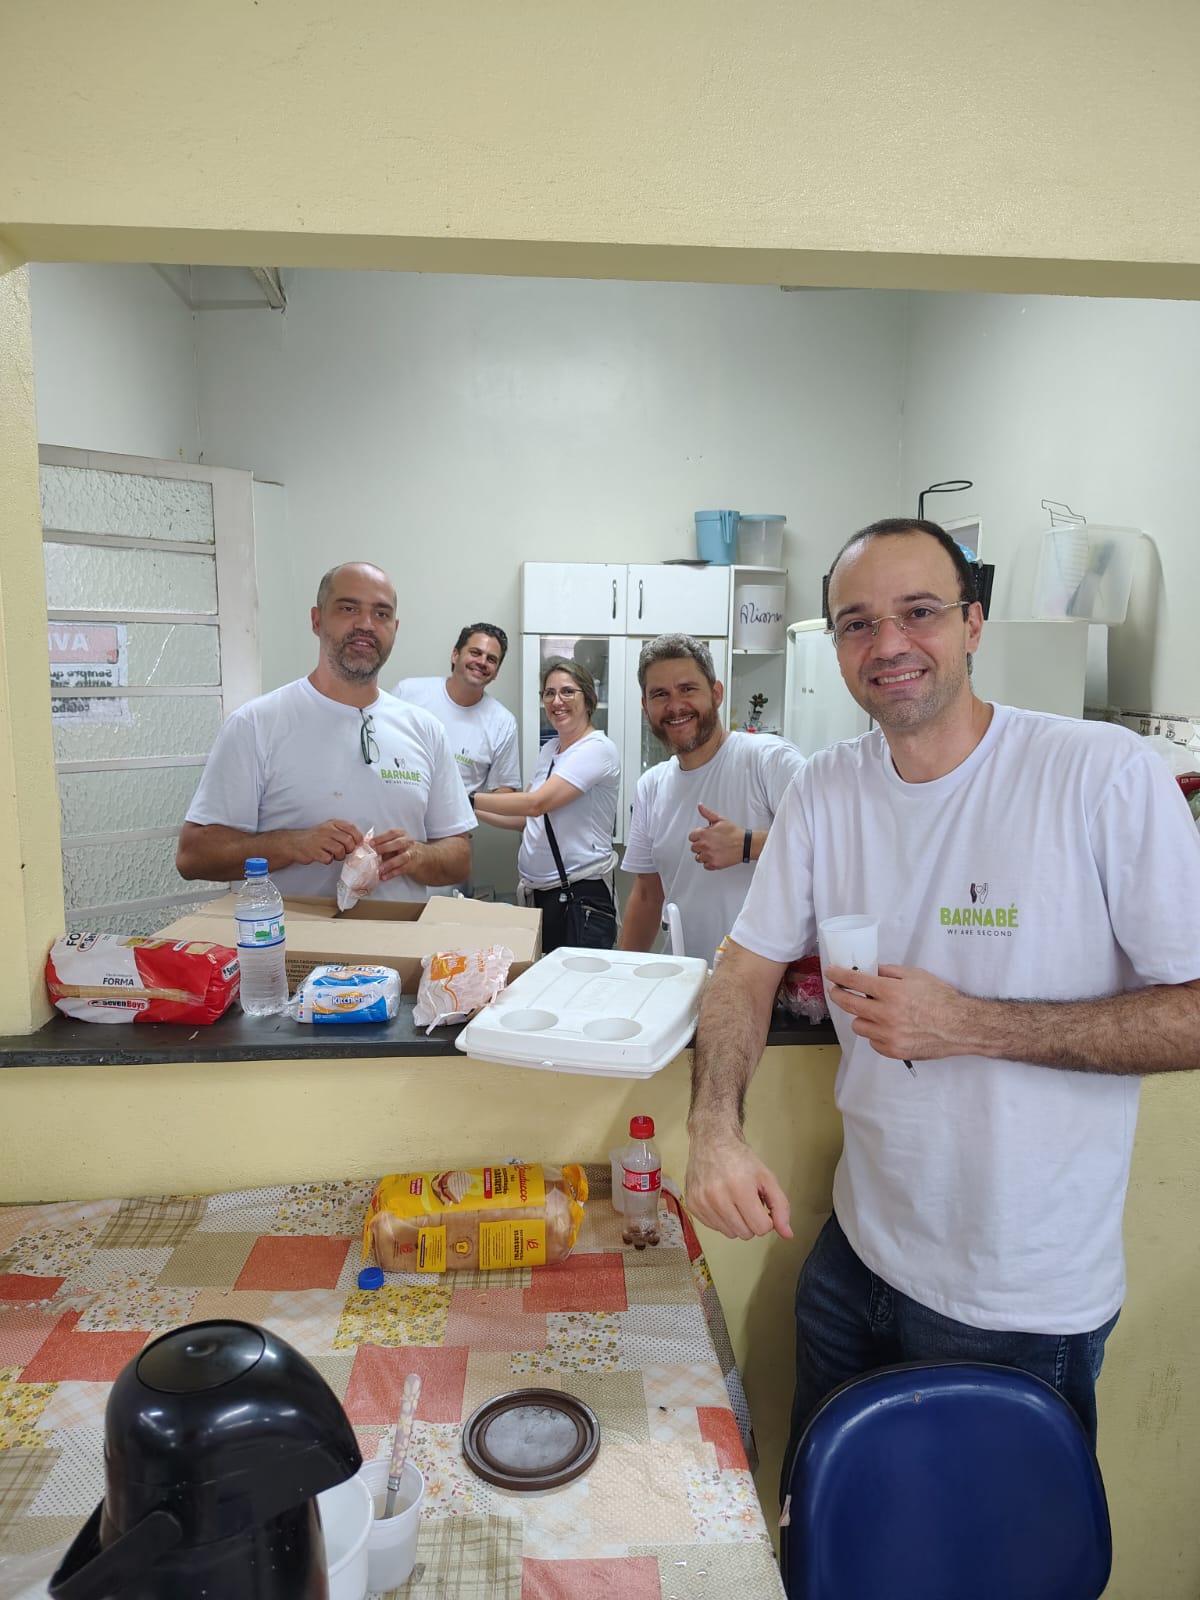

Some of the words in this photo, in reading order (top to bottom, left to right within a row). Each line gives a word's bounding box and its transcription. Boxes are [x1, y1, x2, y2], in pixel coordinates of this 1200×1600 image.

[380, 768, 421, 782] BARNABÉ
[940, 902, 1019, 928] BARNABÉ
[976, 929, 1012, 937] SECOND
[102, 977, 135, 986] FORMA
